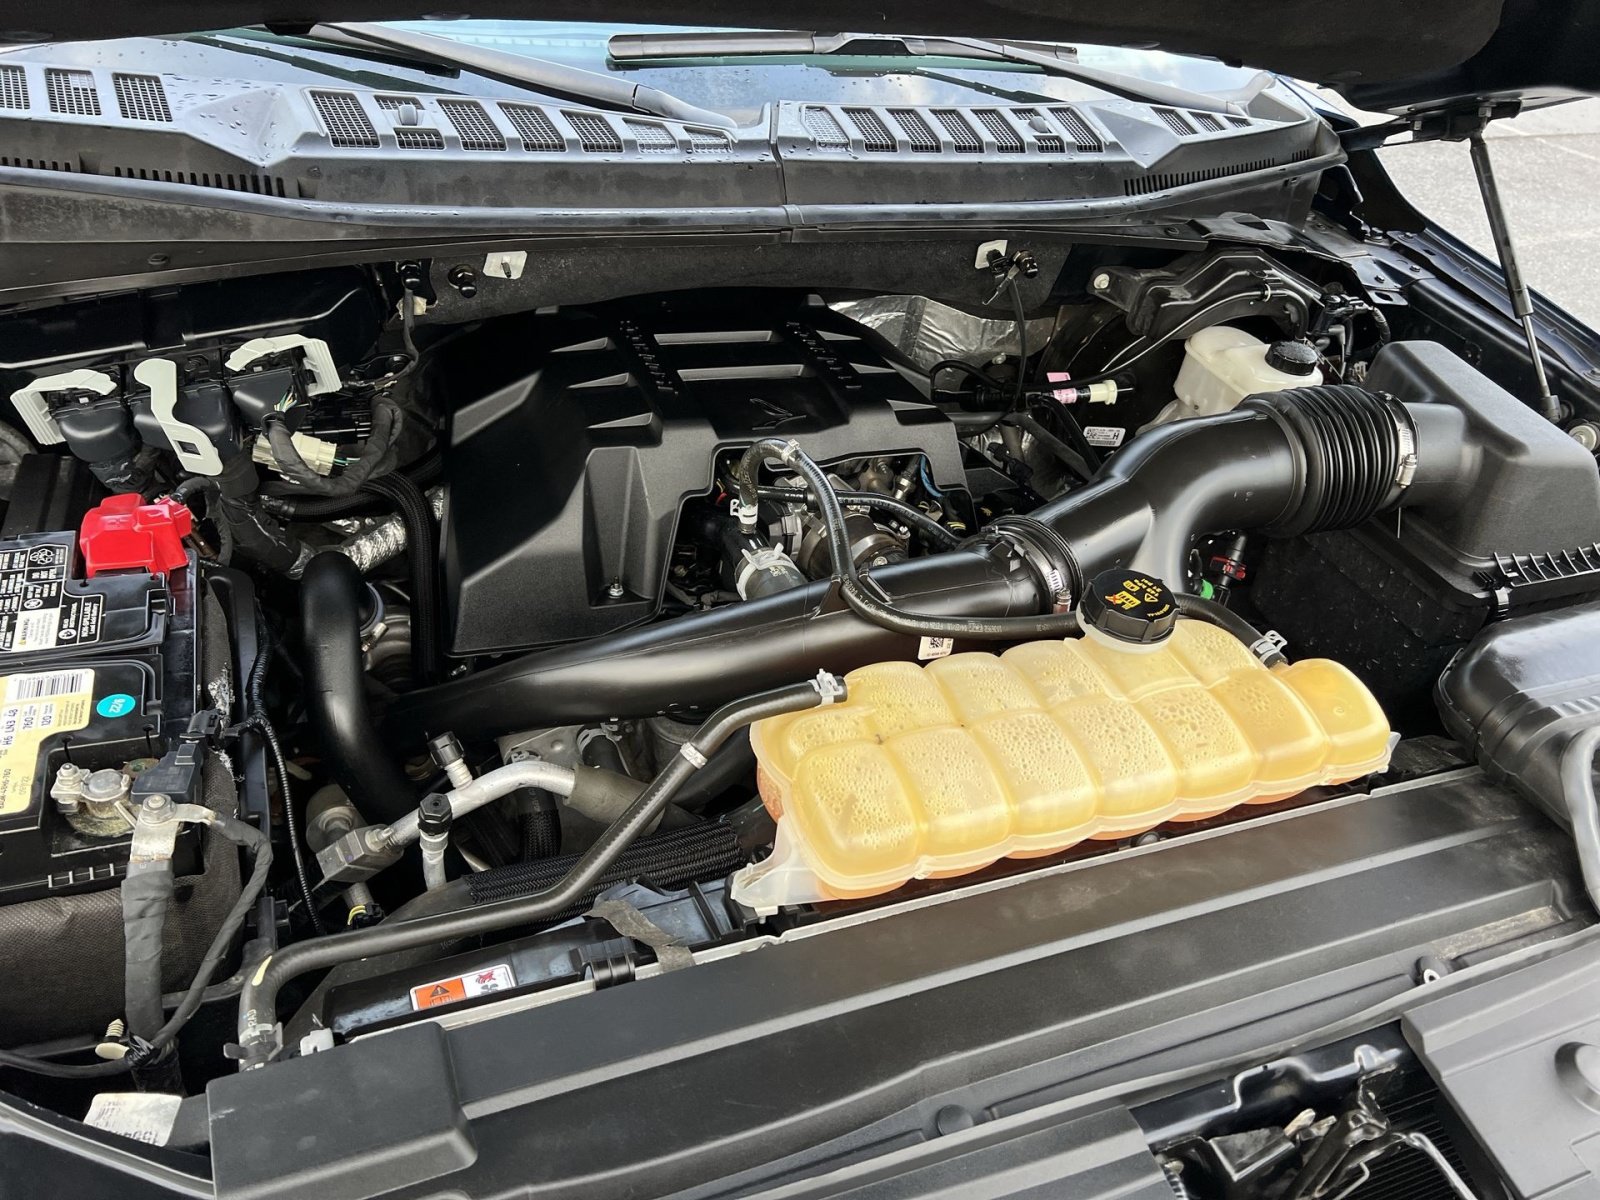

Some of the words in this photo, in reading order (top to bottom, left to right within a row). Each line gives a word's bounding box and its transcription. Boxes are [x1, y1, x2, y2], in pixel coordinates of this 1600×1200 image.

[81, 601, 92, 638] NON-SPILLABLE
[8, 708, 19, 717] 48
[4, 720, 16, 734] LN3
[22, 716, 34, 730] 760
[41, 715, 52, 727] 120
[2, 735, 13, 746] H6
[246, 1008, 257, 1028] RAD
